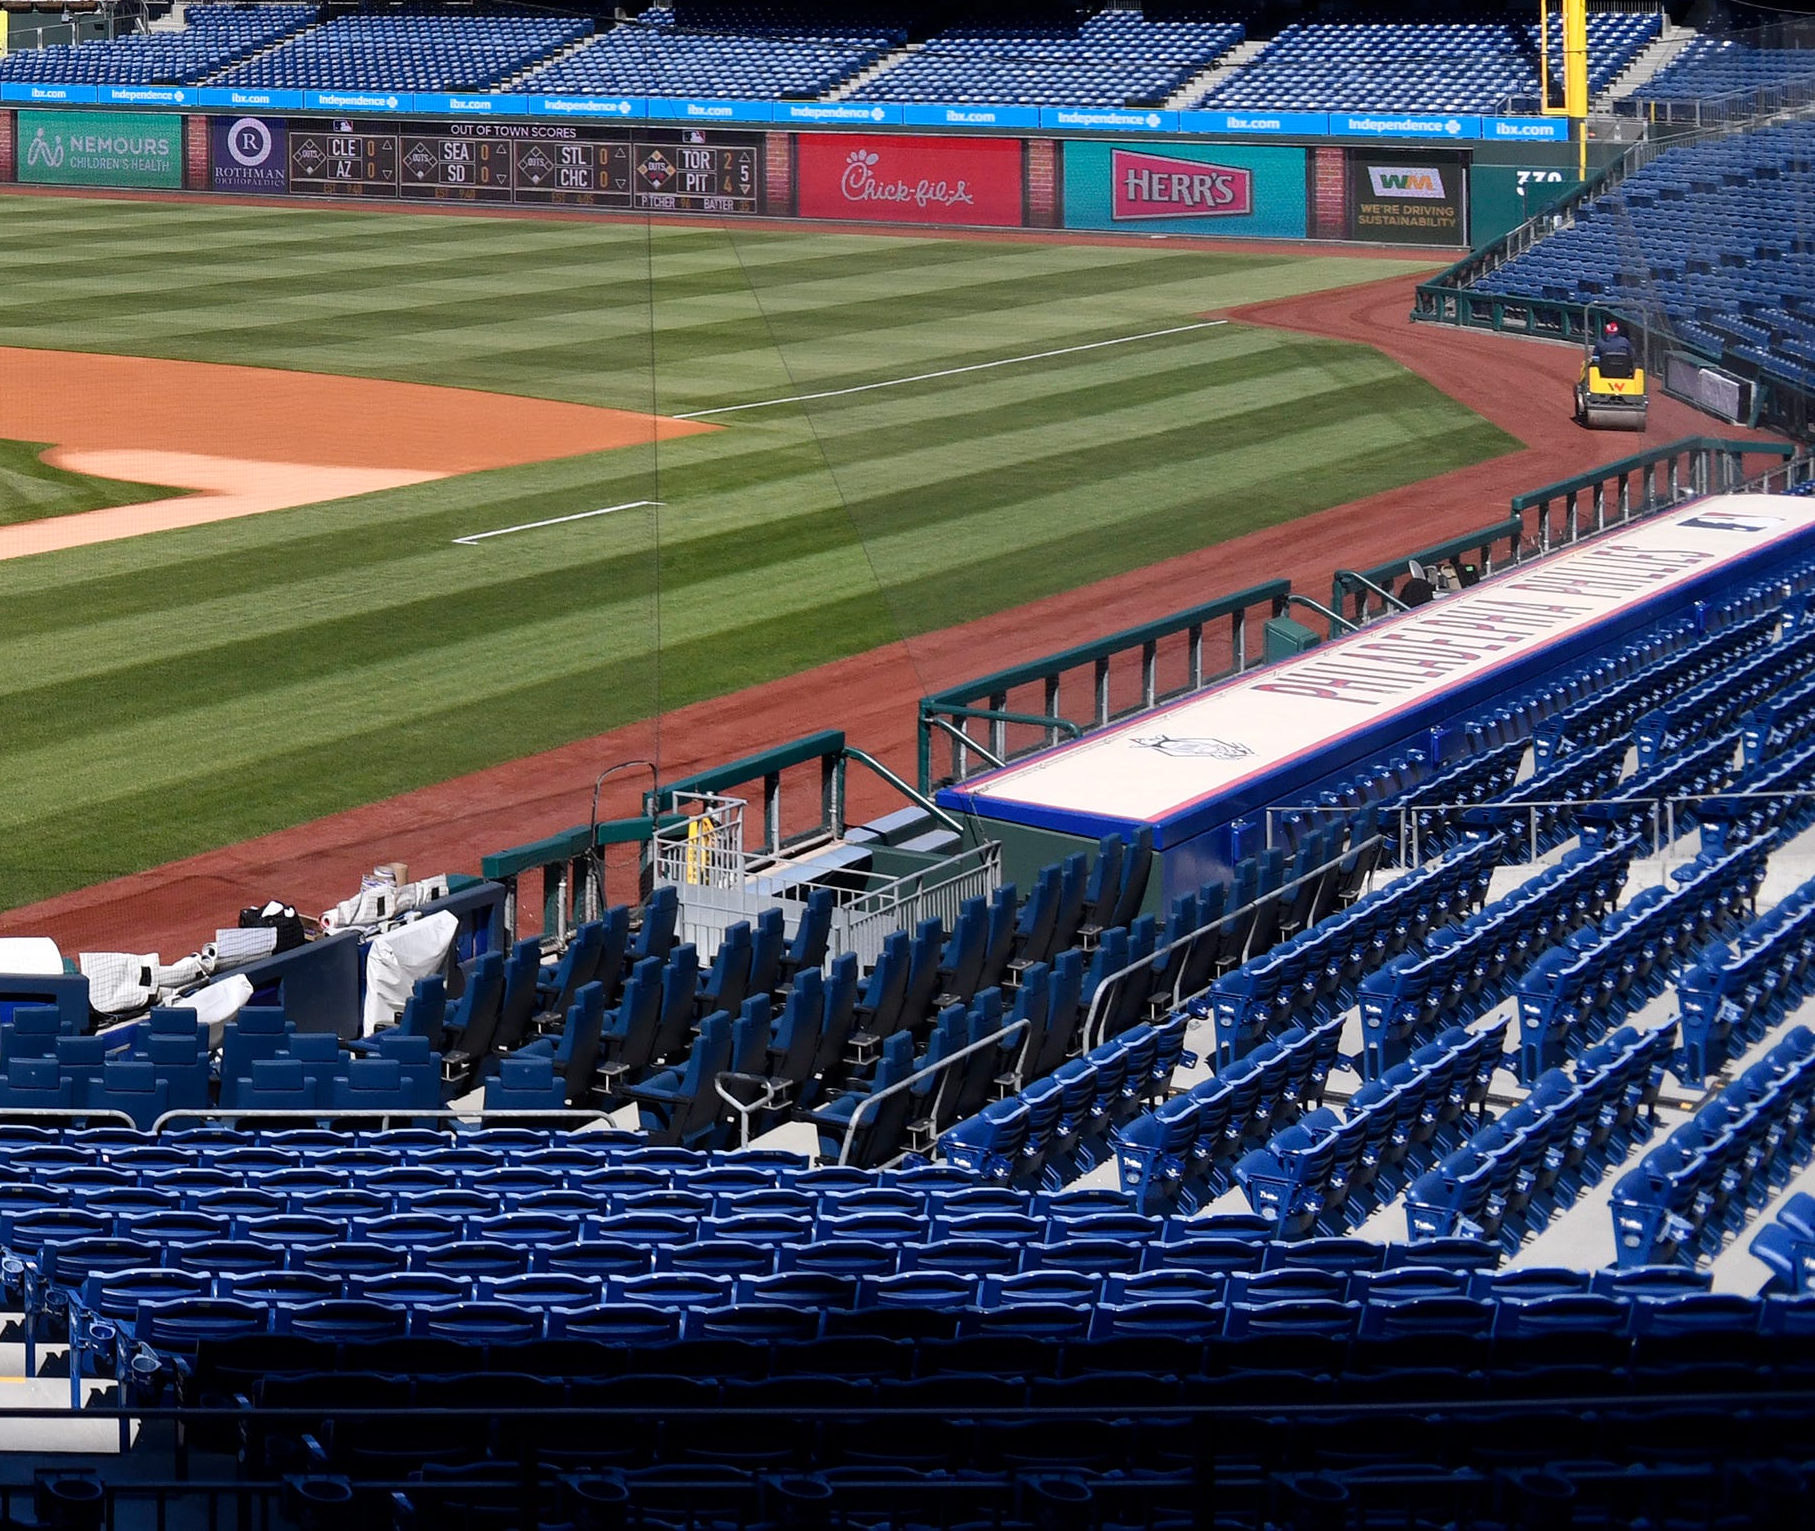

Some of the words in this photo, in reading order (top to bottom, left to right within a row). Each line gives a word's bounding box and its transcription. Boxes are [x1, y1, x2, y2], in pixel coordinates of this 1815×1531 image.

[1227, 117, 1280, 129] ibx.com
[1348, 118, 1442, 133] Independence
[1496, 122, 1554, 136] ibx.com
[451, 125, 474, 135] OUT
[476, 126, 492, 135] OF
[493, 126, 530, 137] TOWN
[531, 127, 577, 138] SCORES
[71, 136, 169, 156] NEMOURS
[243, 133, 260, 151] R
[332, 140, 355, 156] CLE
[444, 144, 469, 160] SEA
[562, 148, 586, 164] STL
[683, 151, 710, 169] TOR
[71, 156, 130, 170] CHILDREN'S
[131, 159, 169, 172] HEALTH
[336, 162, 351, 177] AZ
[215, 167, 285, 179] ROTHMAN
[448, 165, 465, 182] SD
[561, 169, 587, 187] CHC
[741, 166, 748, 182] 5
[215, 178, 285, 187] ORTHOPAEDICS
[686, 174, 708, 191] PIT
[841, 159, 973, 206] Chick-fil-A
[1124, 169, 1234, 206] HERR'S
[1380, 173, 1435, 191] WM
[1360, 204, 1400, 216] WE'RE
[1403, 205, 1454, 217] DRIVING
[1358, 215, 1456, 228] SUSTAINABILITY
[1250, 599, 1593, 705] PHILADELPHIA
[1507, 544, 1715, 599] PHILLIES
